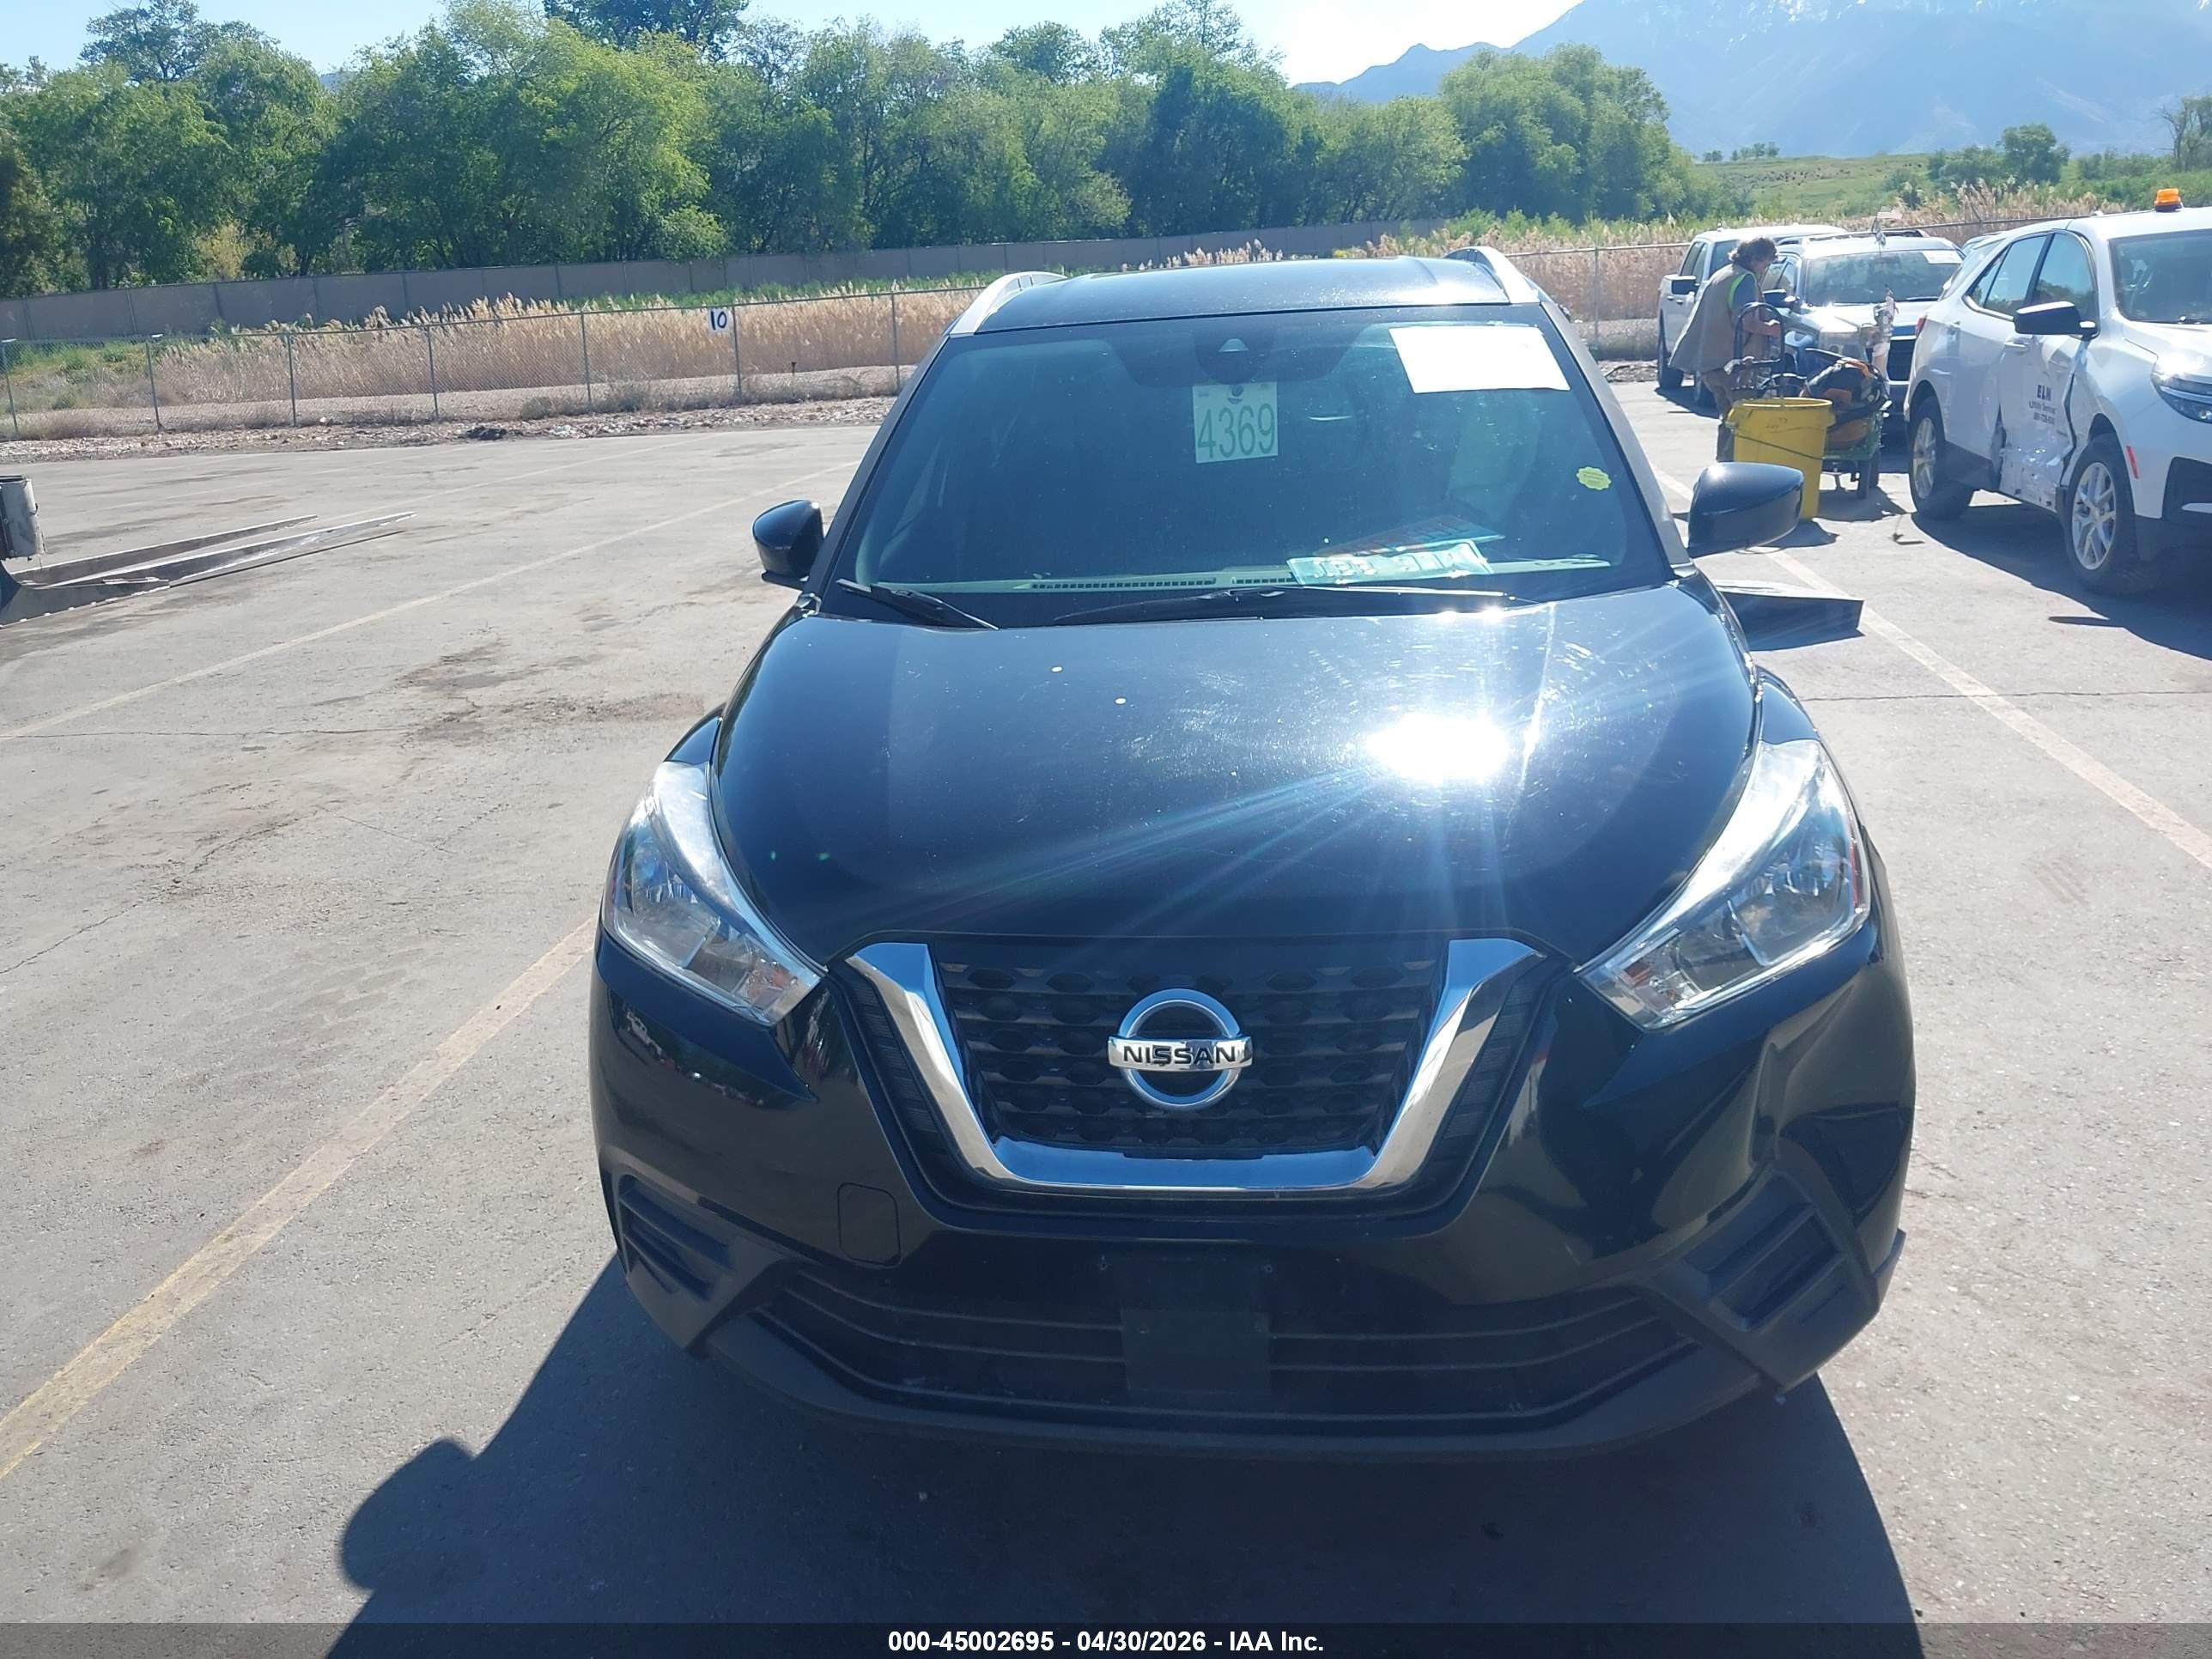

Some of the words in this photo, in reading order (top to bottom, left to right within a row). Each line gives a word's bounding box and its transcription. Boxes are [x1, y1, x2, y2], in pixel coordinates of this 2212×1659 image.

[710, 310, 727, 331] 10
[1198, 404, 1275, 459] 4369
[1123, 1044, 1236, 1065] NISSAN
